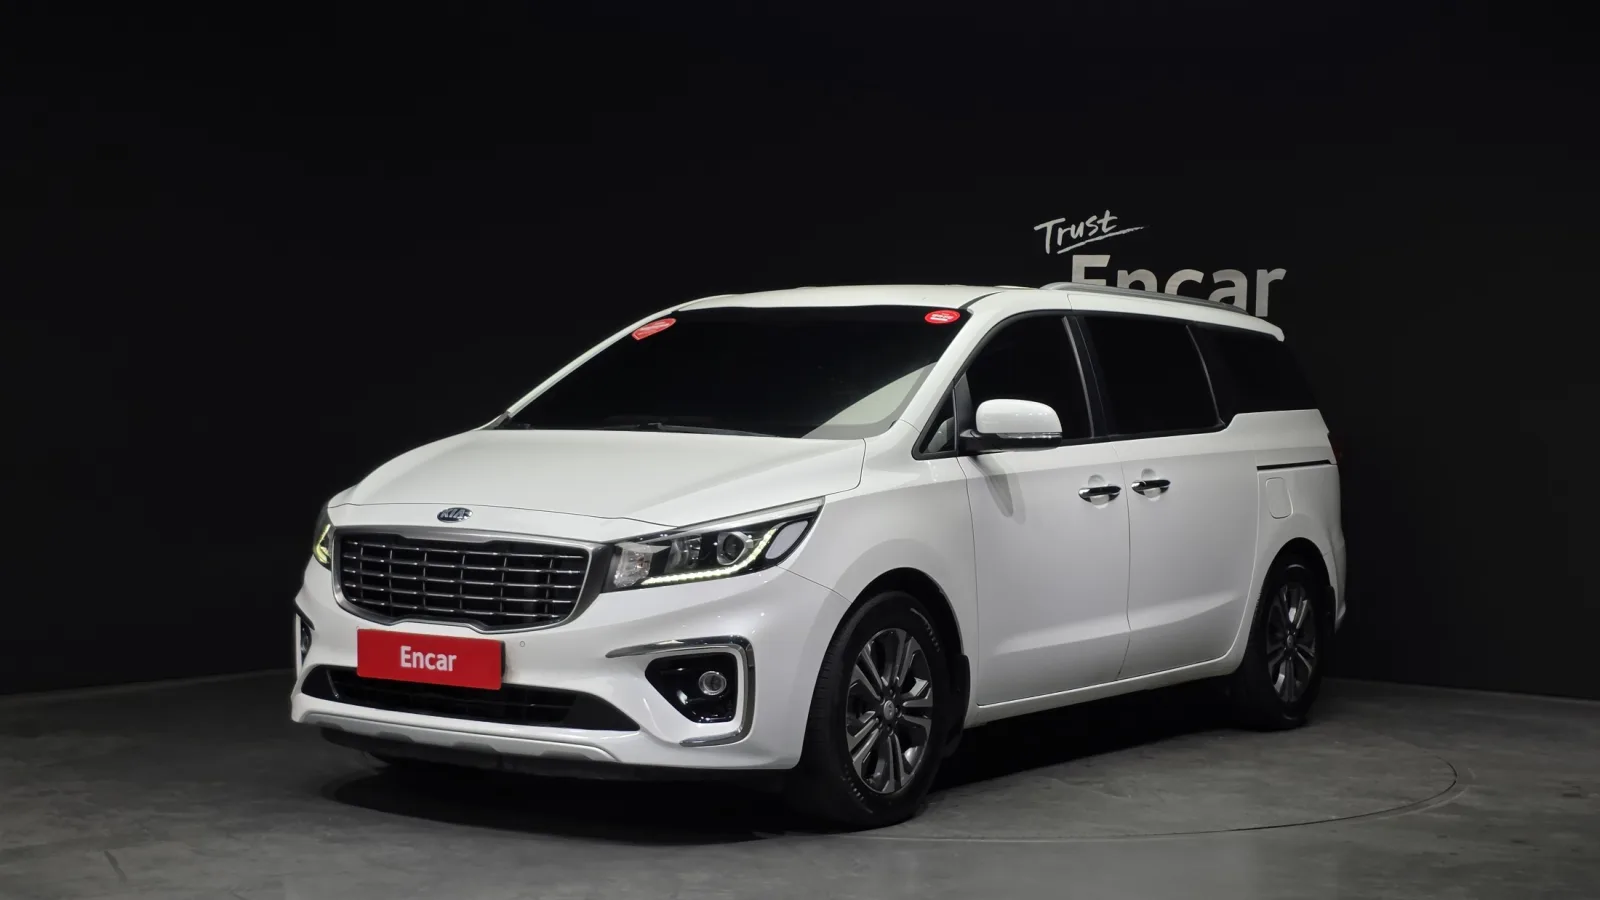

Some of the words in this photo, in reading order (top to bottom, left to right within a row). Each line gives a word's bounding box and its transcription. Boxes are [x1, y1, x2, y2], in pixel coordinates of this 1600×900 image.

[1033, 210, 1118, 254] Trust
[439, 508, 466, 520] KIA
[400, 645, 457, 672] Encar
